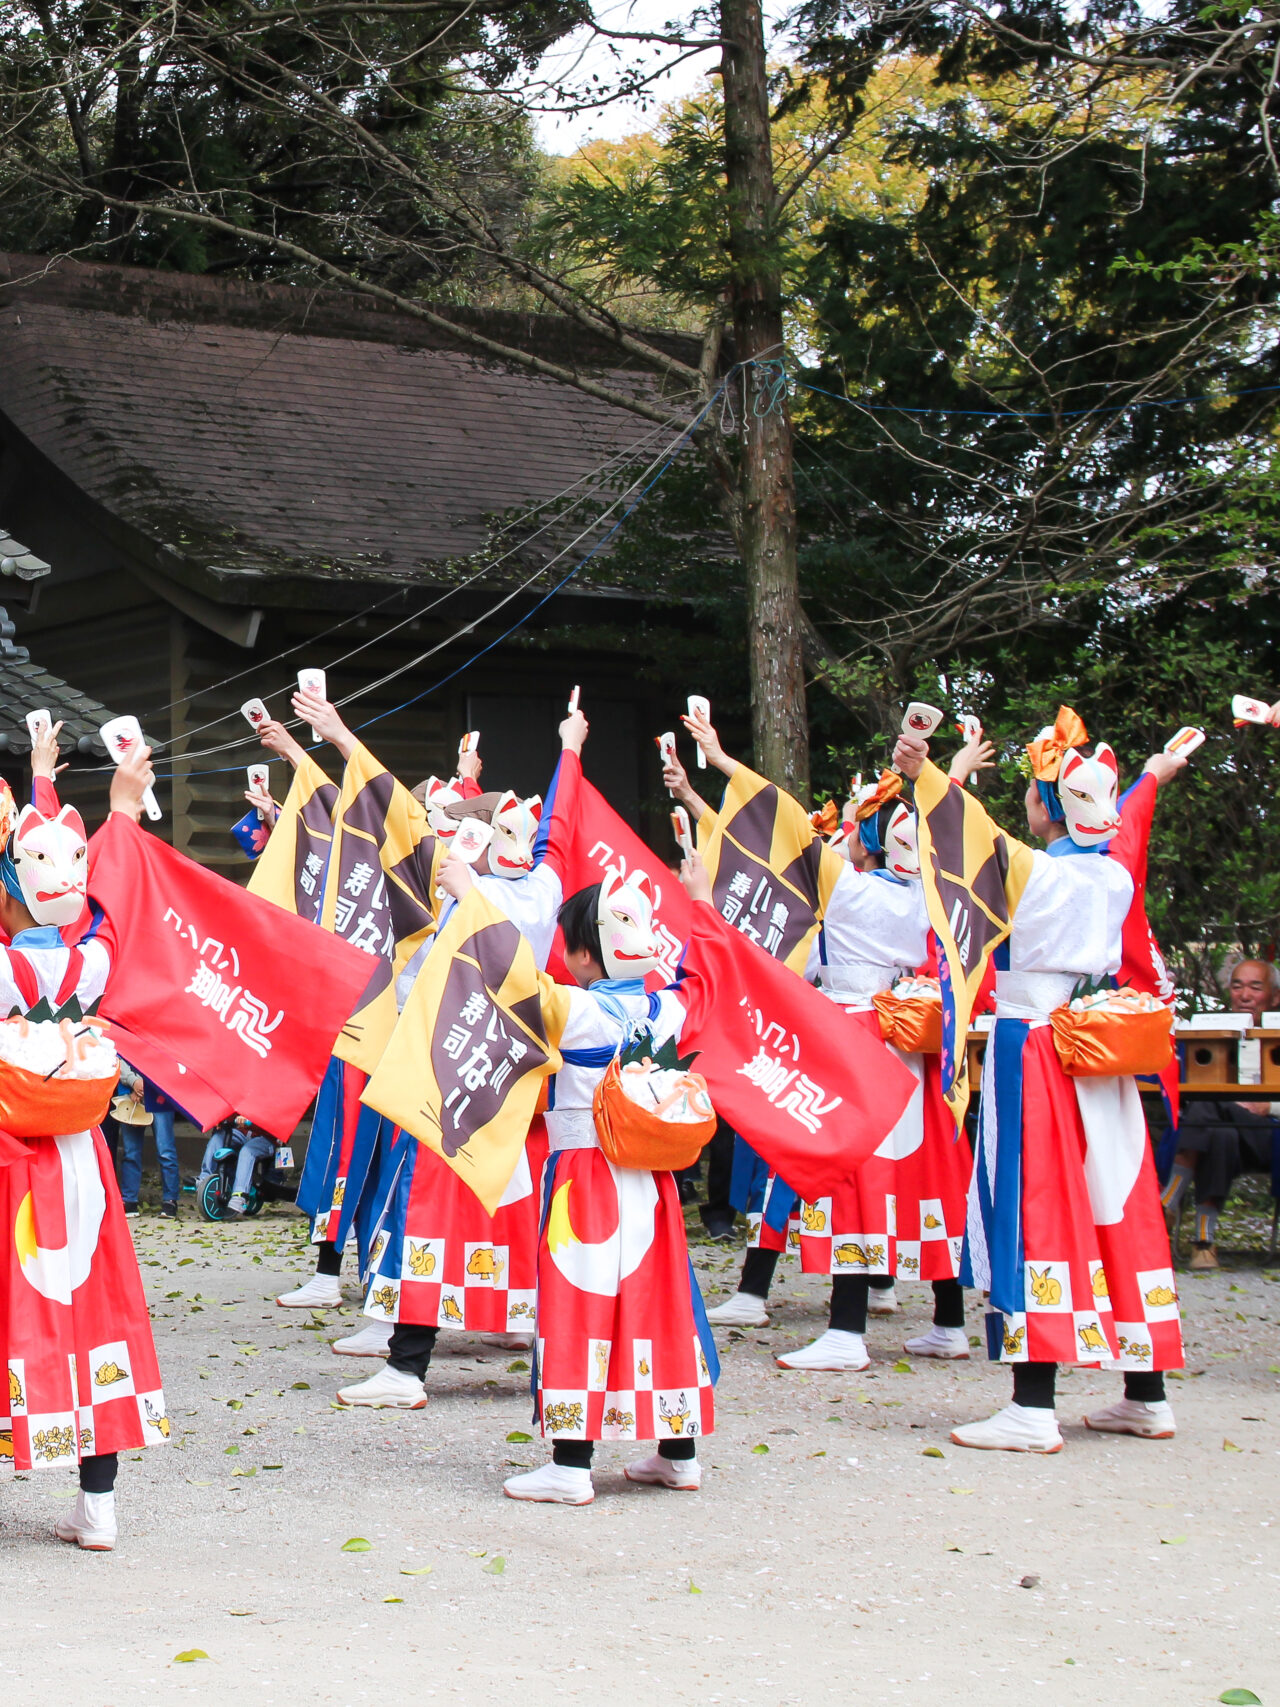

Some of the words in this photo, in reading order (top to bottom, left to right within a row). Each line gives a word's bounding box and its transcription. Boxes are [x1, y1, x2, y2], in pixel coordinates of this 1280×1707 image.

[722, 870, 753, 926] 寿司
[163, 907, 240, 977] コンコン
[442, 991, 489, 1060] 寿司
